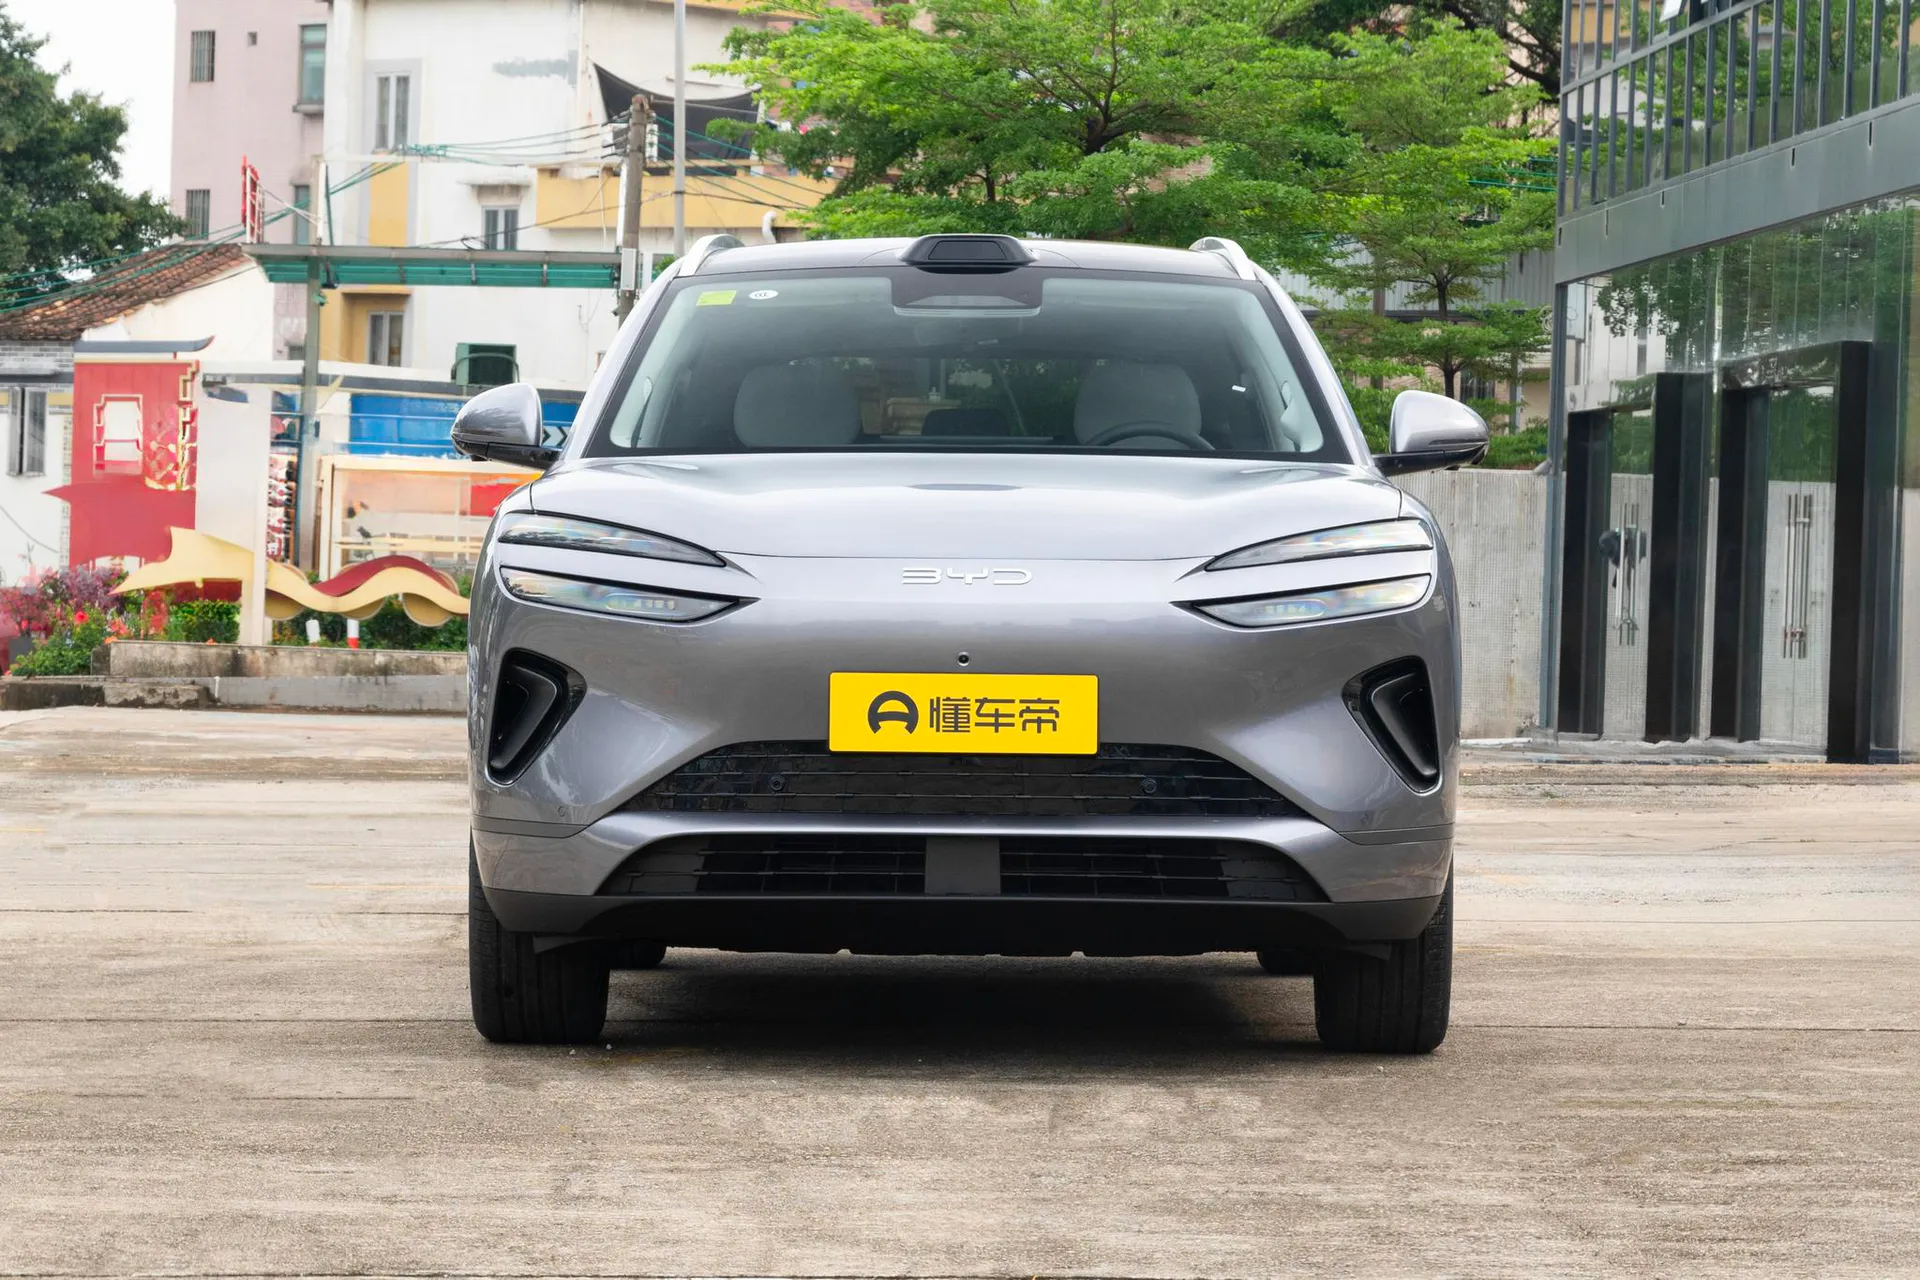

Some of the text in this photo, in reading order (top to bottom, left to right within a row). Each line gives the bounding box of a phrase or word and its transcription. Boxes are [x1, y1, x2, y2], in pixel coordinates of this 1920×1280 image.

[902, 567, 1033, 585] BYD
[929, 696, 1060, 734] 懂车帝
